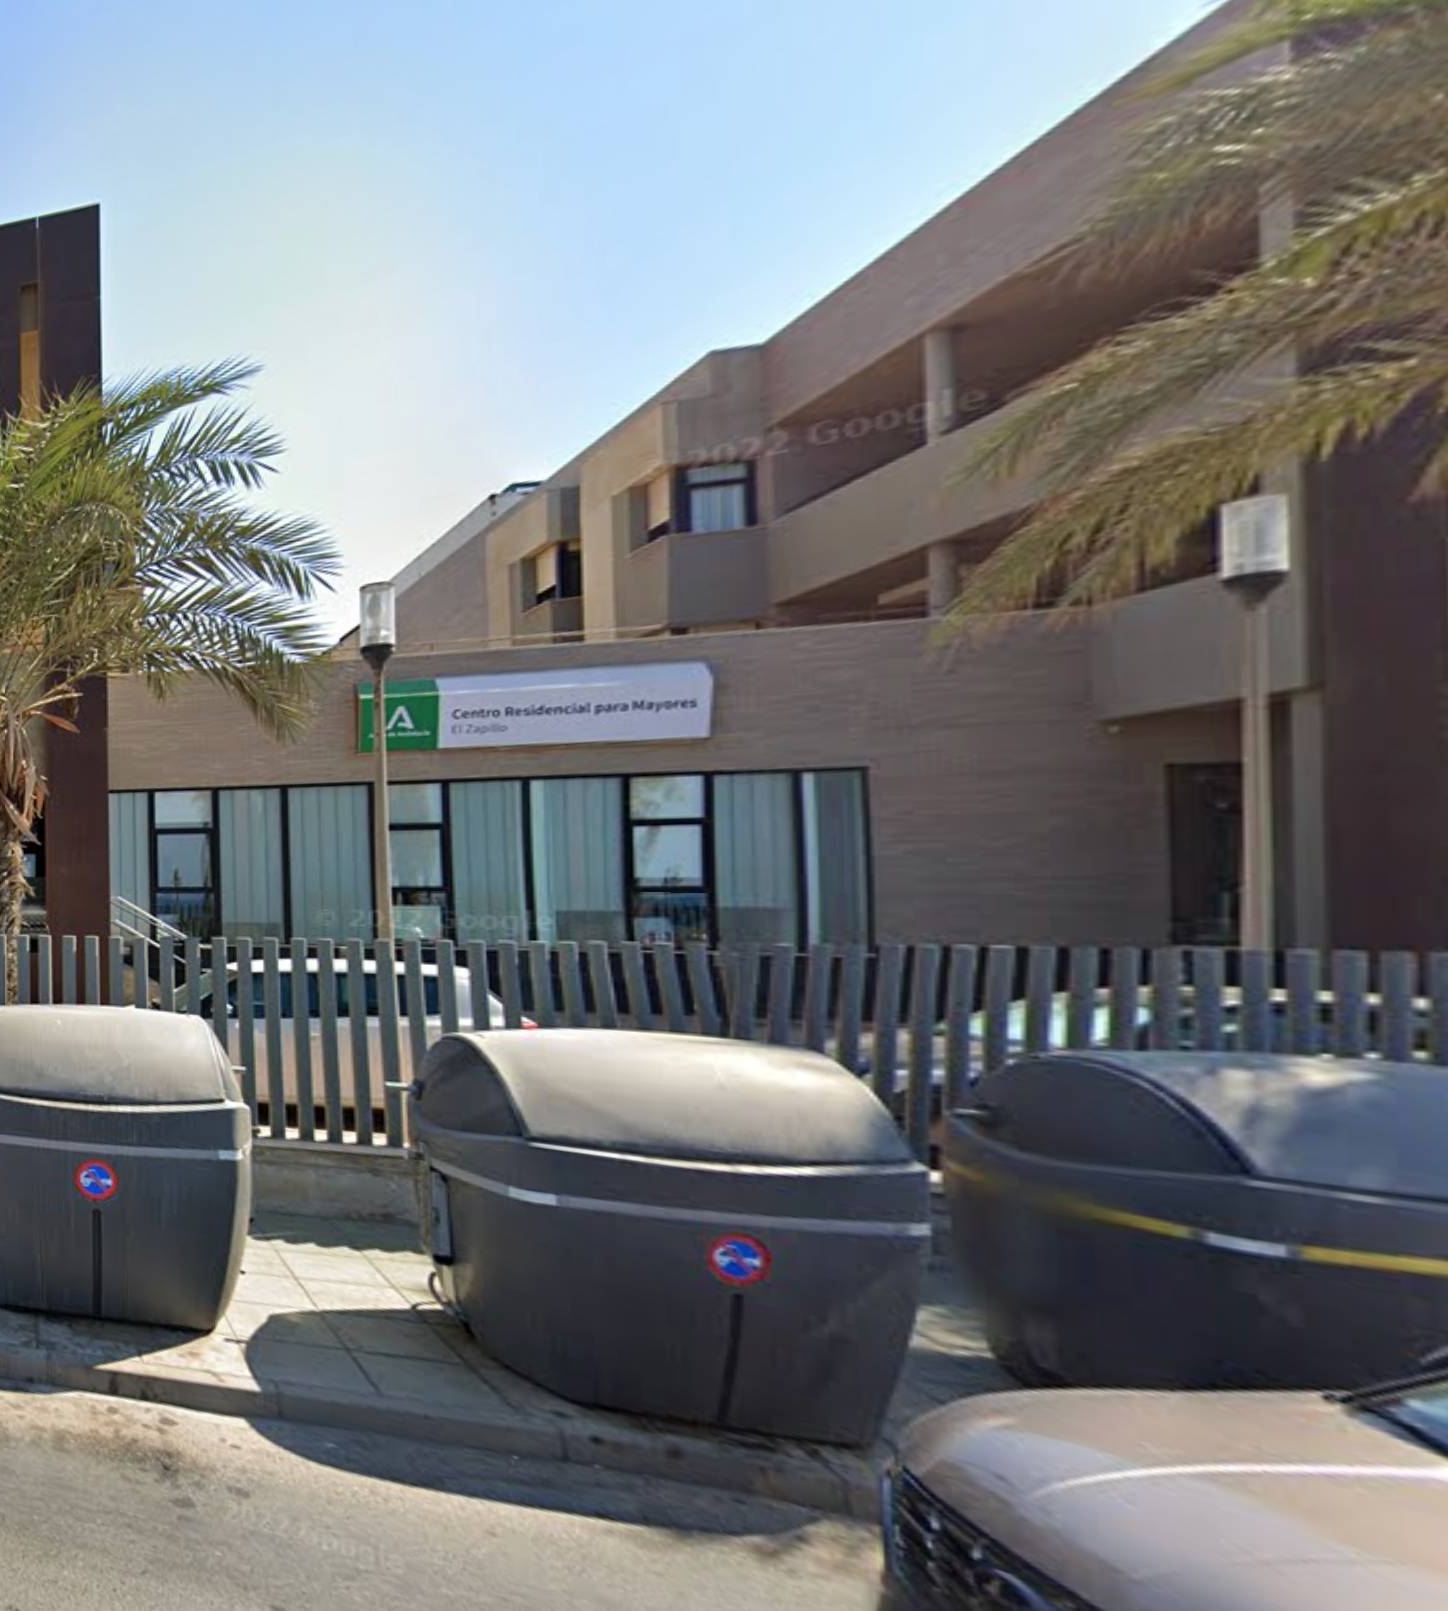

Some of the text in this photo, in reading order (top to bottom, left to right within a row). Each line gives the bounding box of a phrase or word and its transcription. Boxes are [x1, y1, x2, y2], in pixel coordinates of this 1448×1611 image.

[452, 698, 698, 720] Centro Residencial para Mayores
[451, 722, 509, 734] El Zapillo
